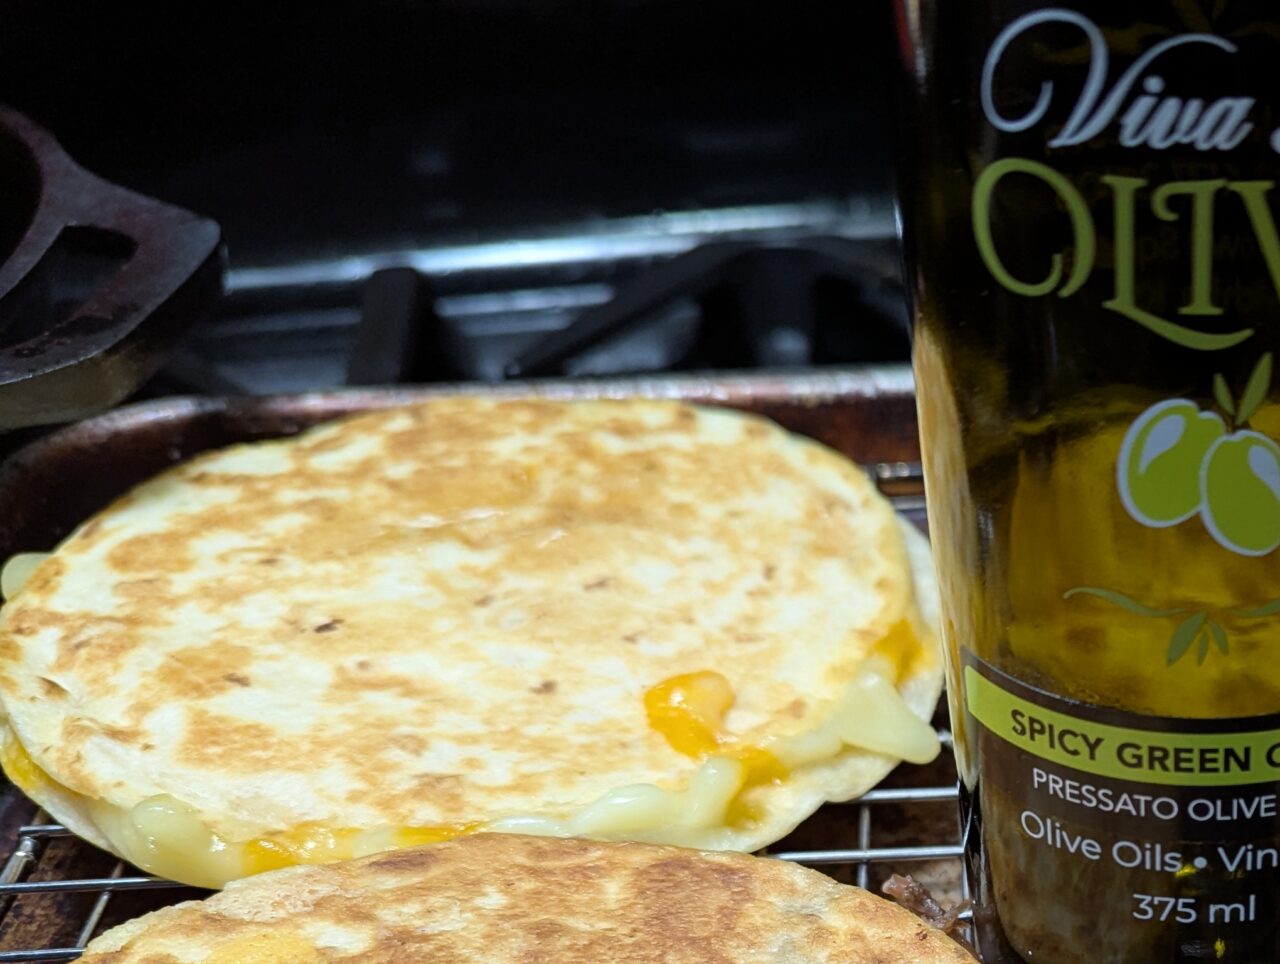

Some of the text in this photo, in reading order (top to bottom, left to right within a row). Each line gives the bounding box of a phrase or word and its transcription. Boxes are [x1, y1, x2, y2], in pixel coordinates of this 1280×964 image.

[980, 8, 1256, 150] Viva
[1010, 708, 1105, 761] SPICY
[1116, 742, 1252, 773] GREEN
[1032, 768, 1179, 820] PRESSATO
[1187, 796, 1277, 821] OLIVE
[1020, 811, 1101, 860] Olive
[1111, 841, 1183, 872] Oils
[1132, 894, 1256, 924] 375 ml
